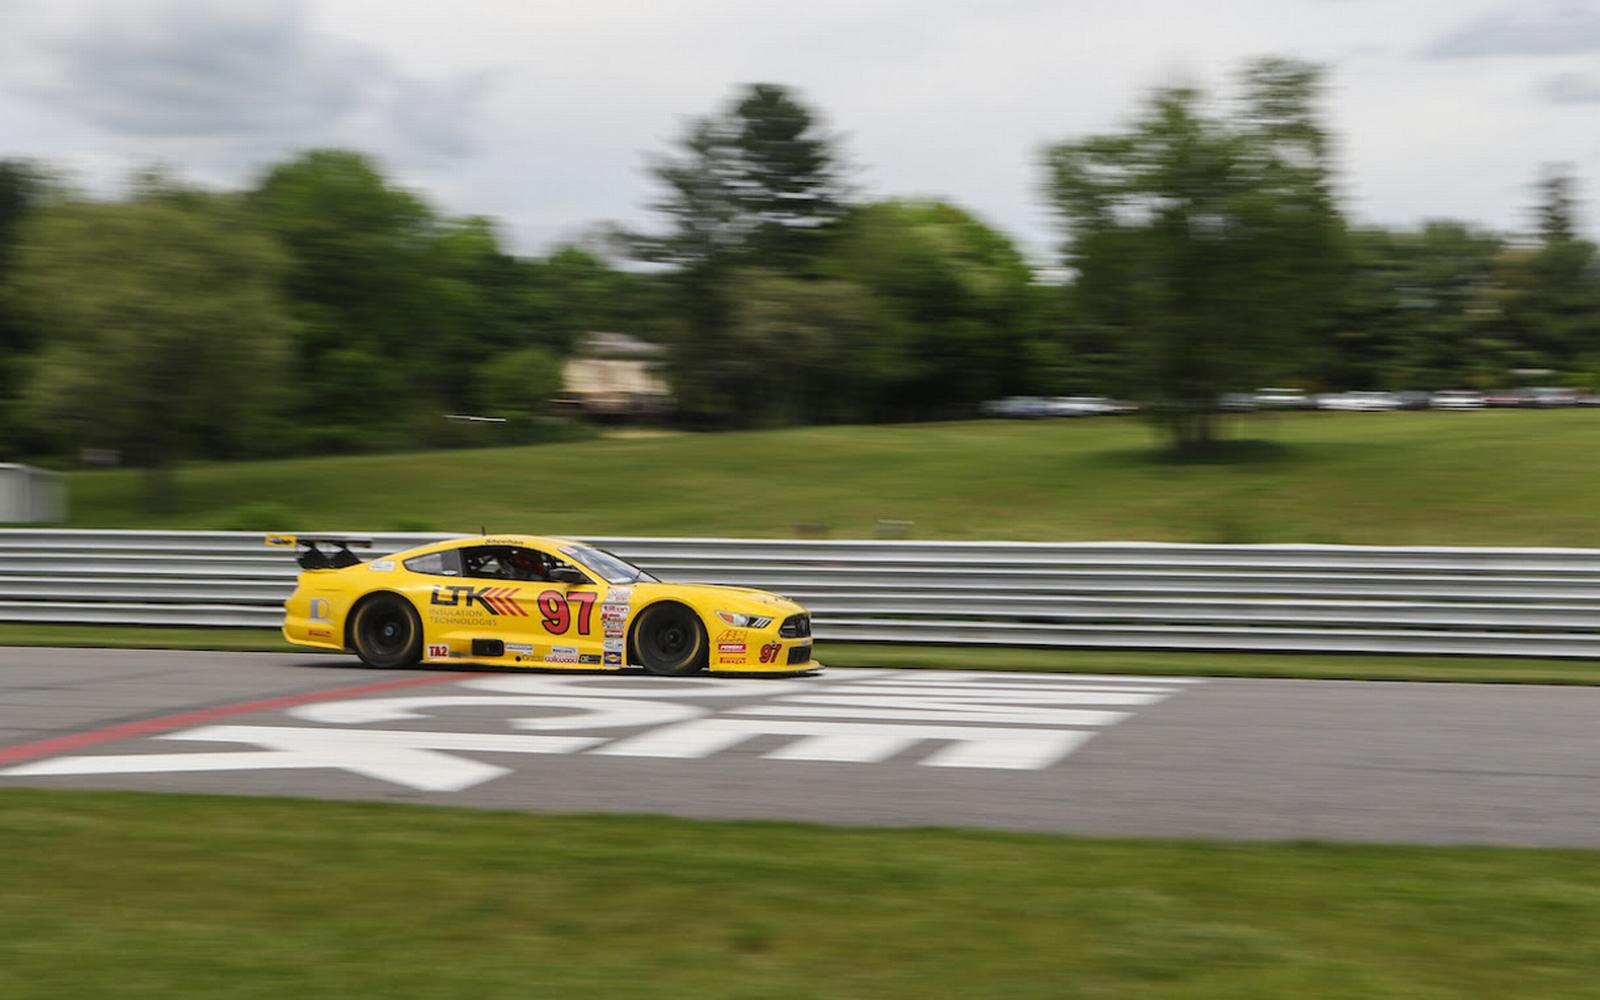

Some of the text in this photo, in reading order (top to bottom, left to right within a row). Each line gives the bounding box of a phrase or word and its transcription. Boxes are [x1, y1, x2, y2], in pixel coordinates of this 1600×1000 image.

[430, 585, 499, 615] LTK
[430, 609, 482, 617] INSULATION
[537, 590, 597, 635] 97
[430, 616, 496, 626] TECHNOLOGIES
[429, 646, 448, 657] TA2
[759, 643, 782, 664] 97
